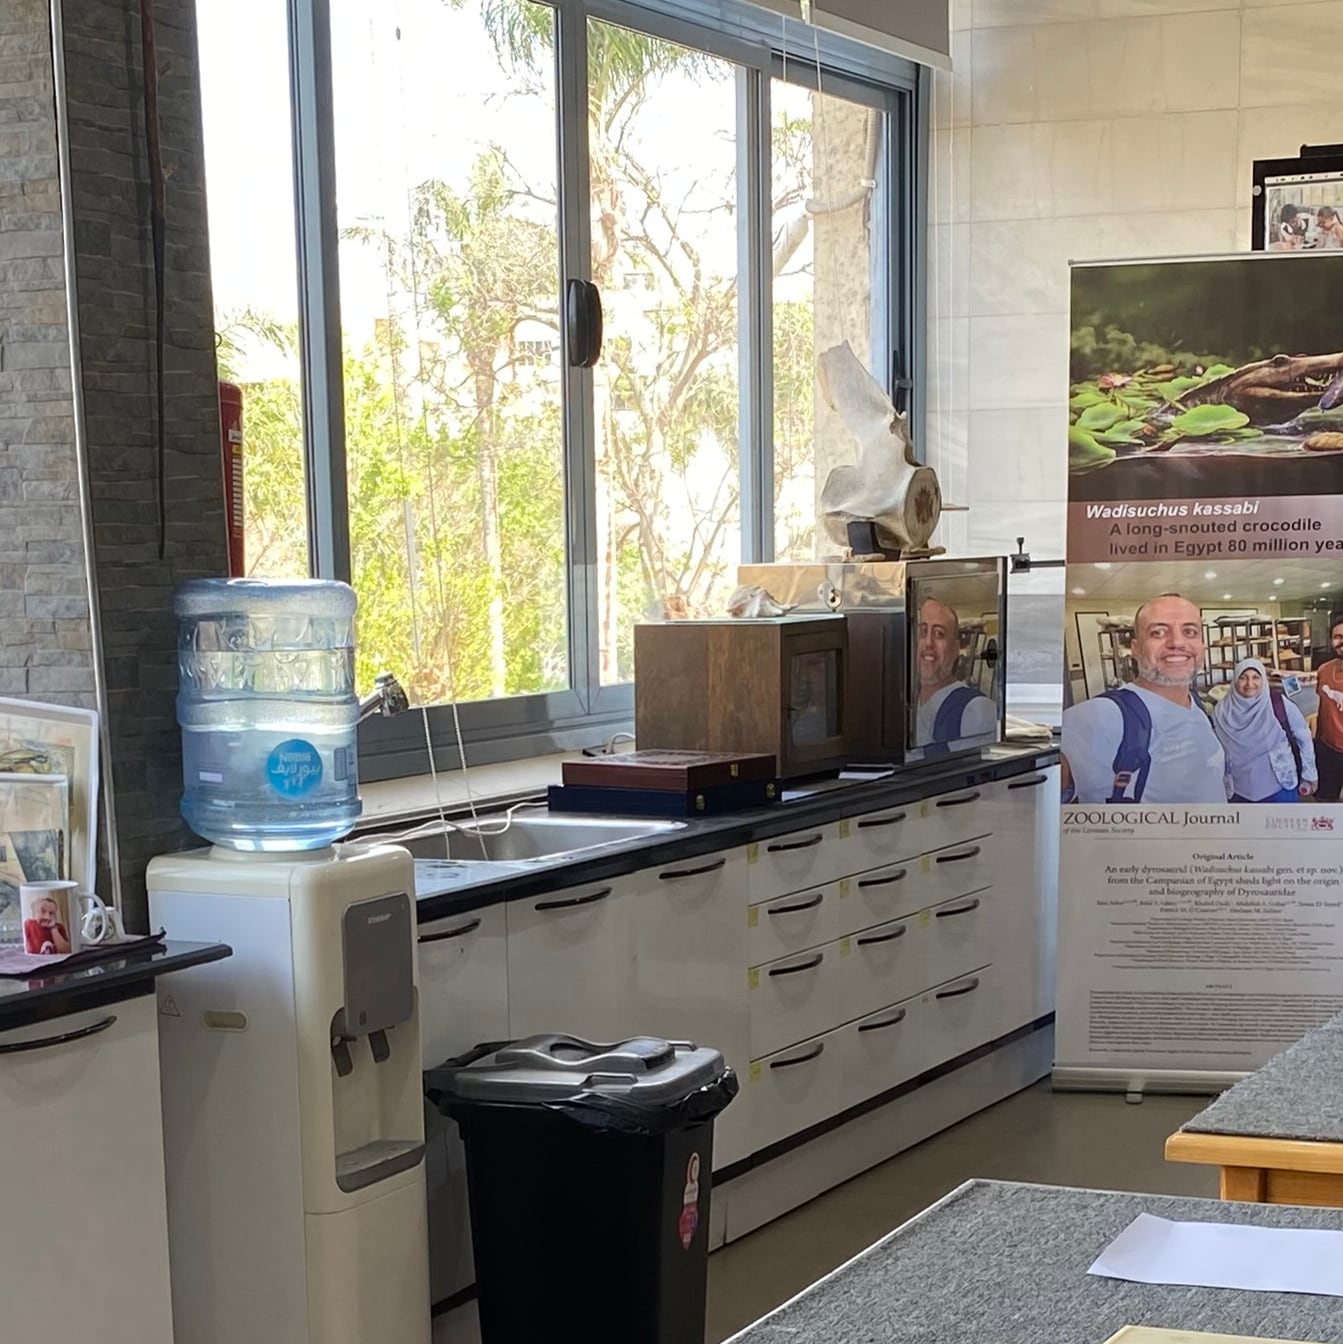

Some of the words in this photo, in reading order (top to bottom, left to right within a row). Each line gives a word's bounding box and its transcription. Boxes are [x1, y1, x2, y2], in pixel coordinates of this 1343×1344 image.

[1086, 502, 1189, 519] Wadisuchus
[1193, 500, 1259, 516] kassabi
[1109, 523, 1122, 536] A
[1126, 520, 1237, 537] long-snouted
[1242, 518, 1322, 532] crocodile
[1109, 542, 1148, 555] lived
[1154, 541, 1169, 554] in
[1174, 540, 1222, 556] Egypt
[1228, 539, 1247, 552] 80
[1253, 538, 1309, 552] million
[1063, 811, 1179, 825] ZOOLOGICAL
[1183, 811, 1240, 827] Journal
[1192, 853, 1226, 861] Original
[1104, 865, 1117, 873] An
[1119, 865, 1139, 875] early
[1107, 876, 1129, 884] from
[1130, 876, 1144, 884] the
[1197, 876, 1207, 884] of
[1208, 877, 1233, 887] Egypt
[1297, 877, 1311, 885] the
[1313, 877, 1340, 887] origin
[1149, 888, 1165, 896] and
